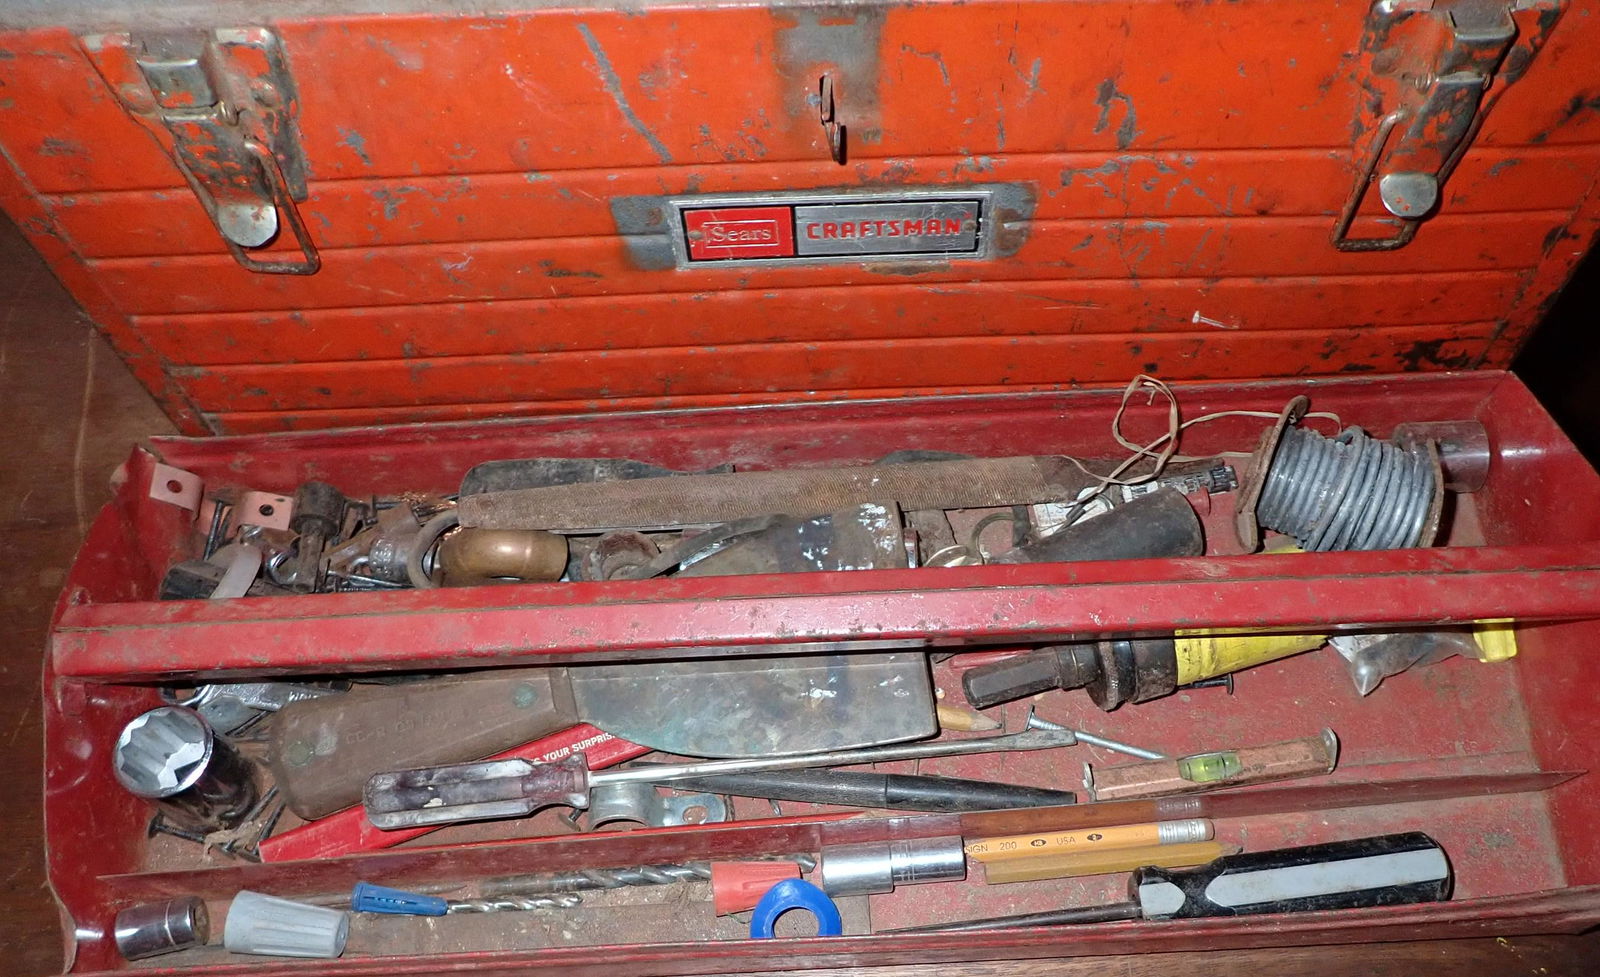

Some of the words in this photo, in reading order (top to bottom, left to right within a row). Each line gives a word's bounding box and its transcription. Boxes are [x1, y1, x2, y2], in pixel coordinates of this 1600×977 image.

[711, 226, 772, 243] Sears
[806, 218, 961, 240] CRAFTSMAN
[543, 746, 570, 762] YOUR
[571, 732, 616, 752] SURPRIS
[1000, 841, 1017, 851] 200
[1056, 836, 1076, 846] USA
